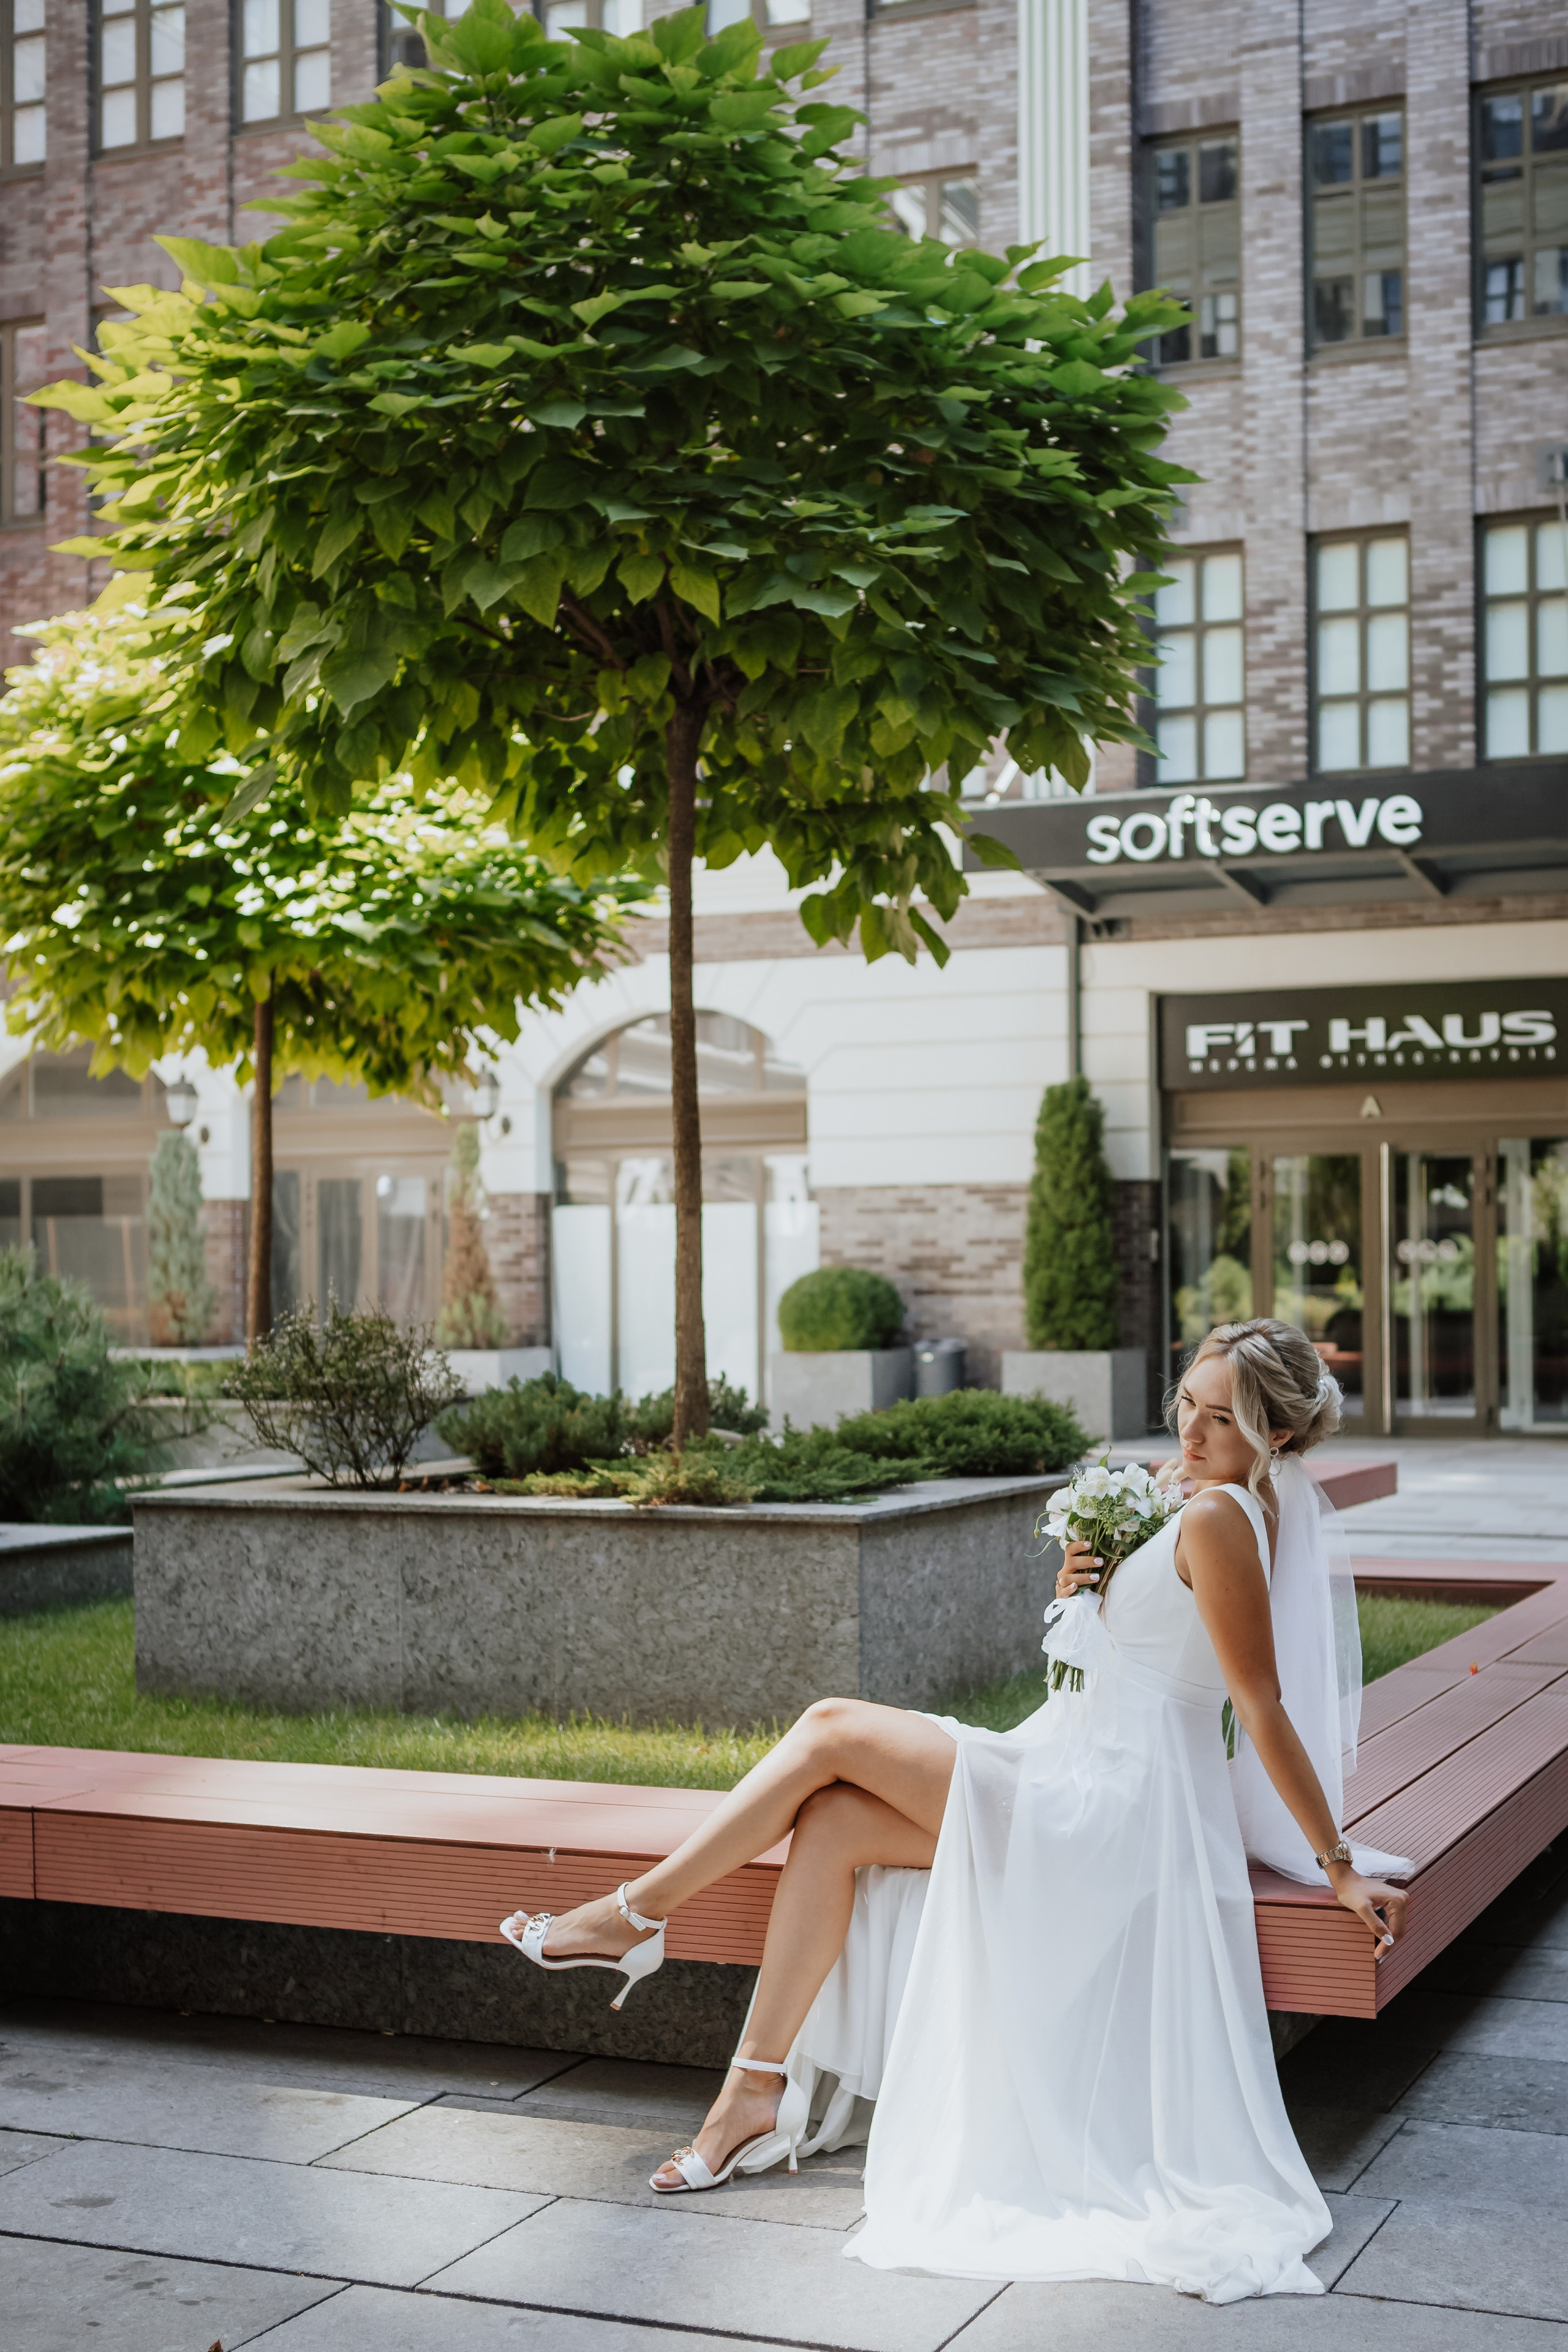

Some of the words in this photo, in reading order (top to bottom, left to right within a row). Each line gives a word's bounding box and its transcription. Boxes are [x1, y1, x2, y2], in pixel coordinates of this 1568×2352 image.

[1085, 793, 1423, 864] softserve
[1185, 1019, 1310, 1060] FIT
[1328, 1009, 1558, 1054] HAUS
